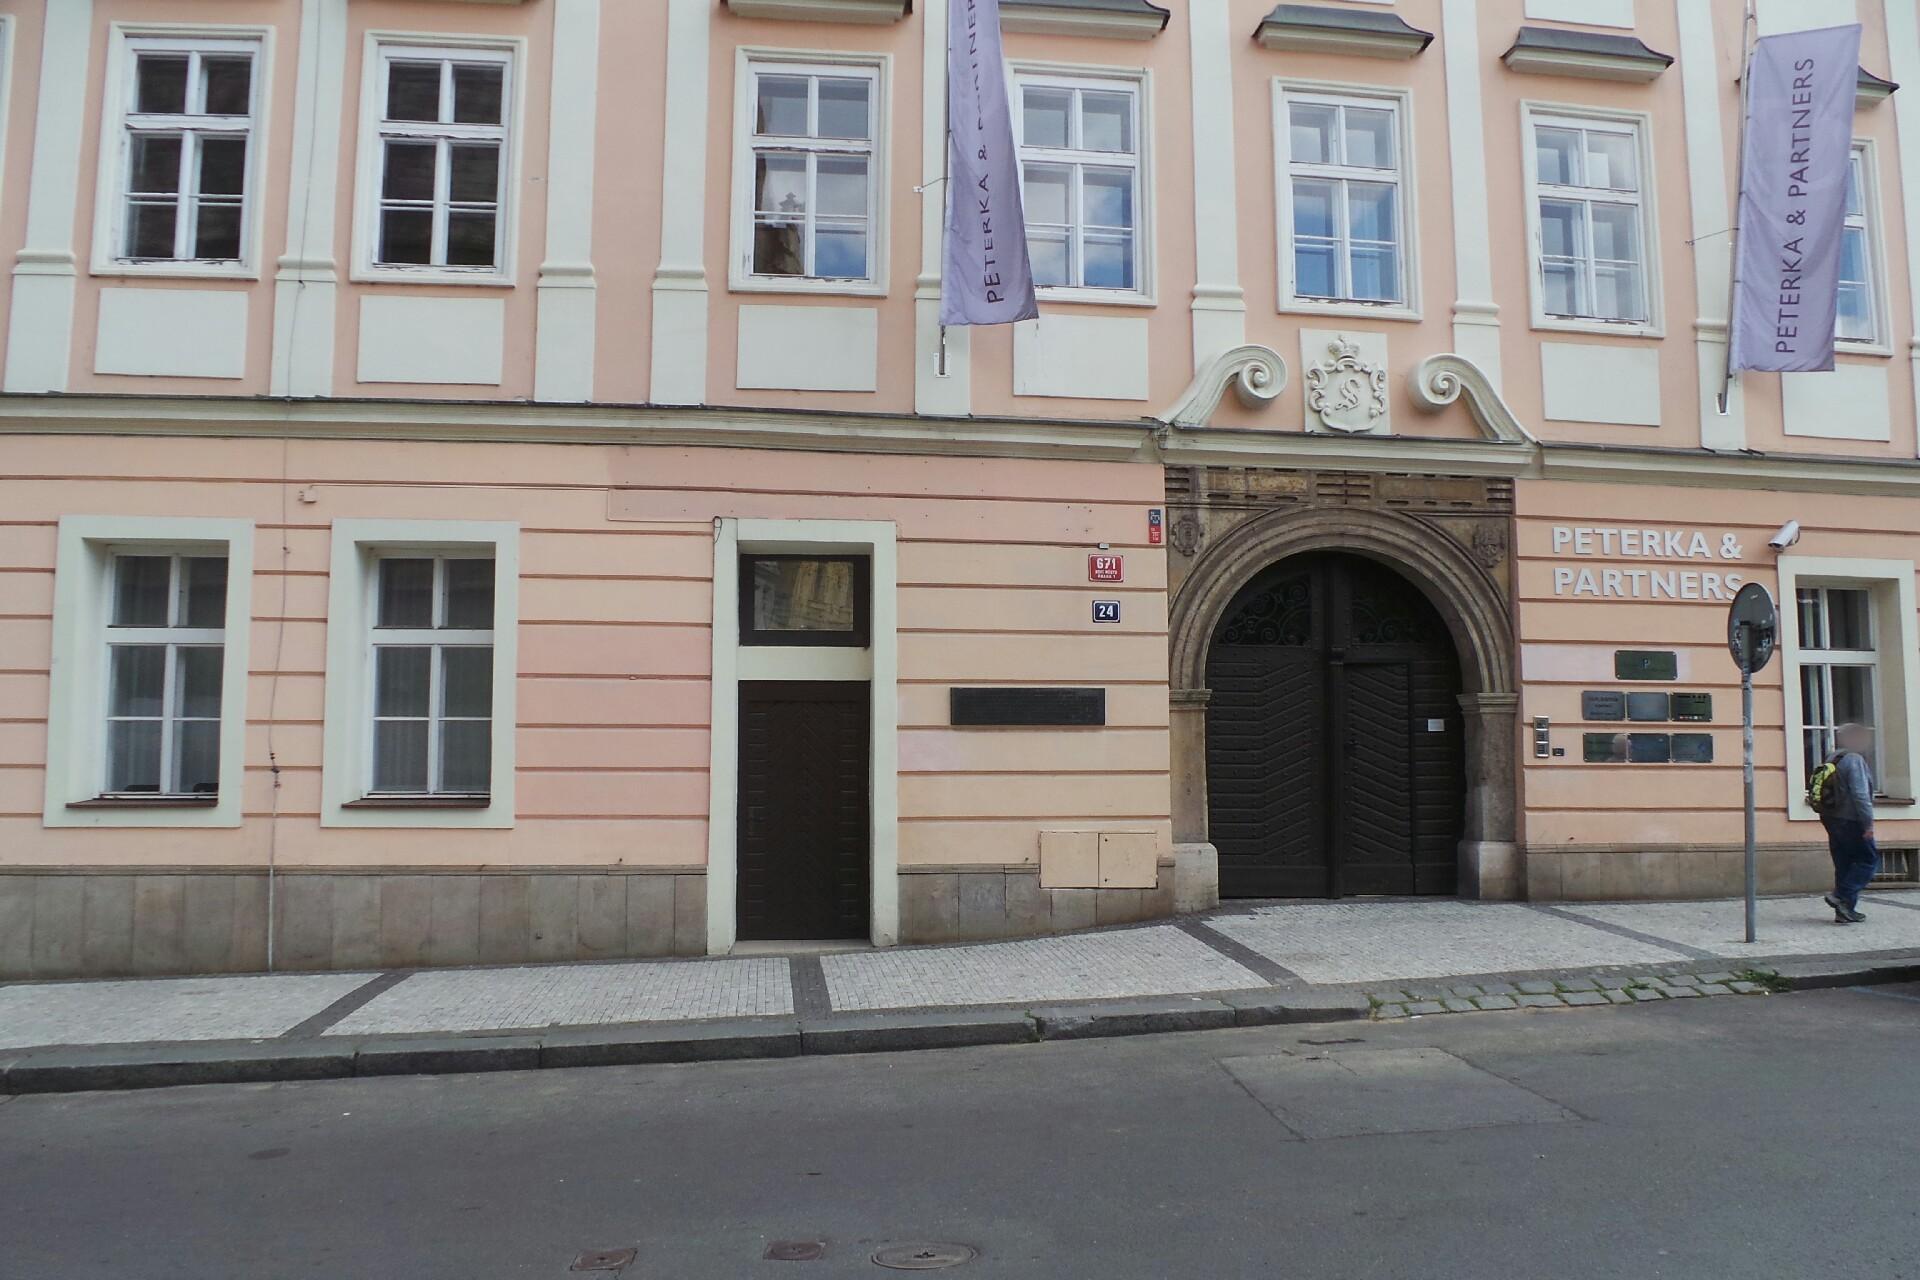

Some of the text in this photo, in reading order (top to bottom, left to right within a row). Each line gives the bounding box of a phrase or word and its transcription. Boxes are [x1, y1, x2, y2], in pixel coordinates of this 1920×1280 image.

[1775, 58, 1815, 353] PETERKA & PARTNERS
[978, 174, 1004, 304] PETERKA
[1552, 526, 1744, 560] PETERKA &
[1096, 557, 1116, 570] 671
[1554, 567, 1745, 601] PARTNERS
[1099, 605, 1114, 618] 24
